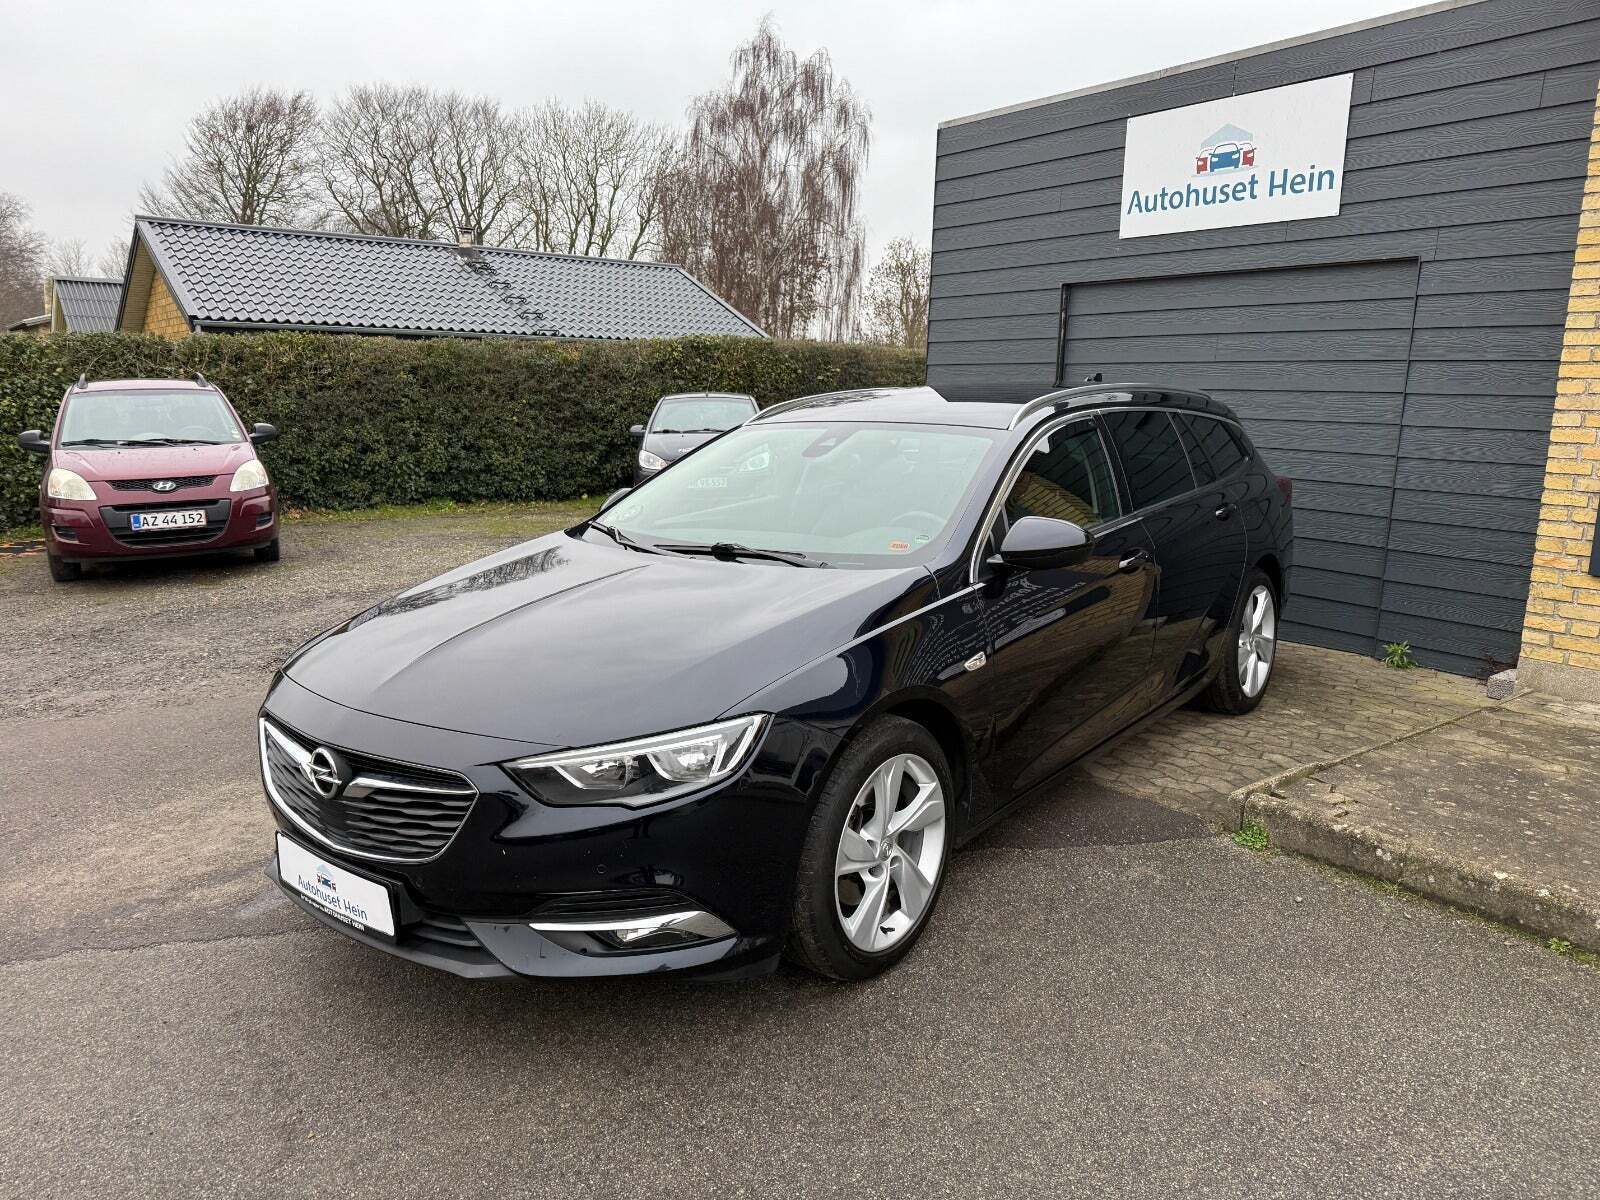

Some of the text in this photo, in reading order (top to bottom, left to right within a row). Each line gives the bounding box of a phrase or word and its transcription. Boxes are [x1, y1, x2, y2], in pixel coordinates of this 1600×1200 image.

[1127, 164, 1335, 215] Autohuset Hein
[142, 512, 204, 527] AZ 44 152
[298, 874, 342, 909] Autohuset
[343, 898, 368, 921] Hein
